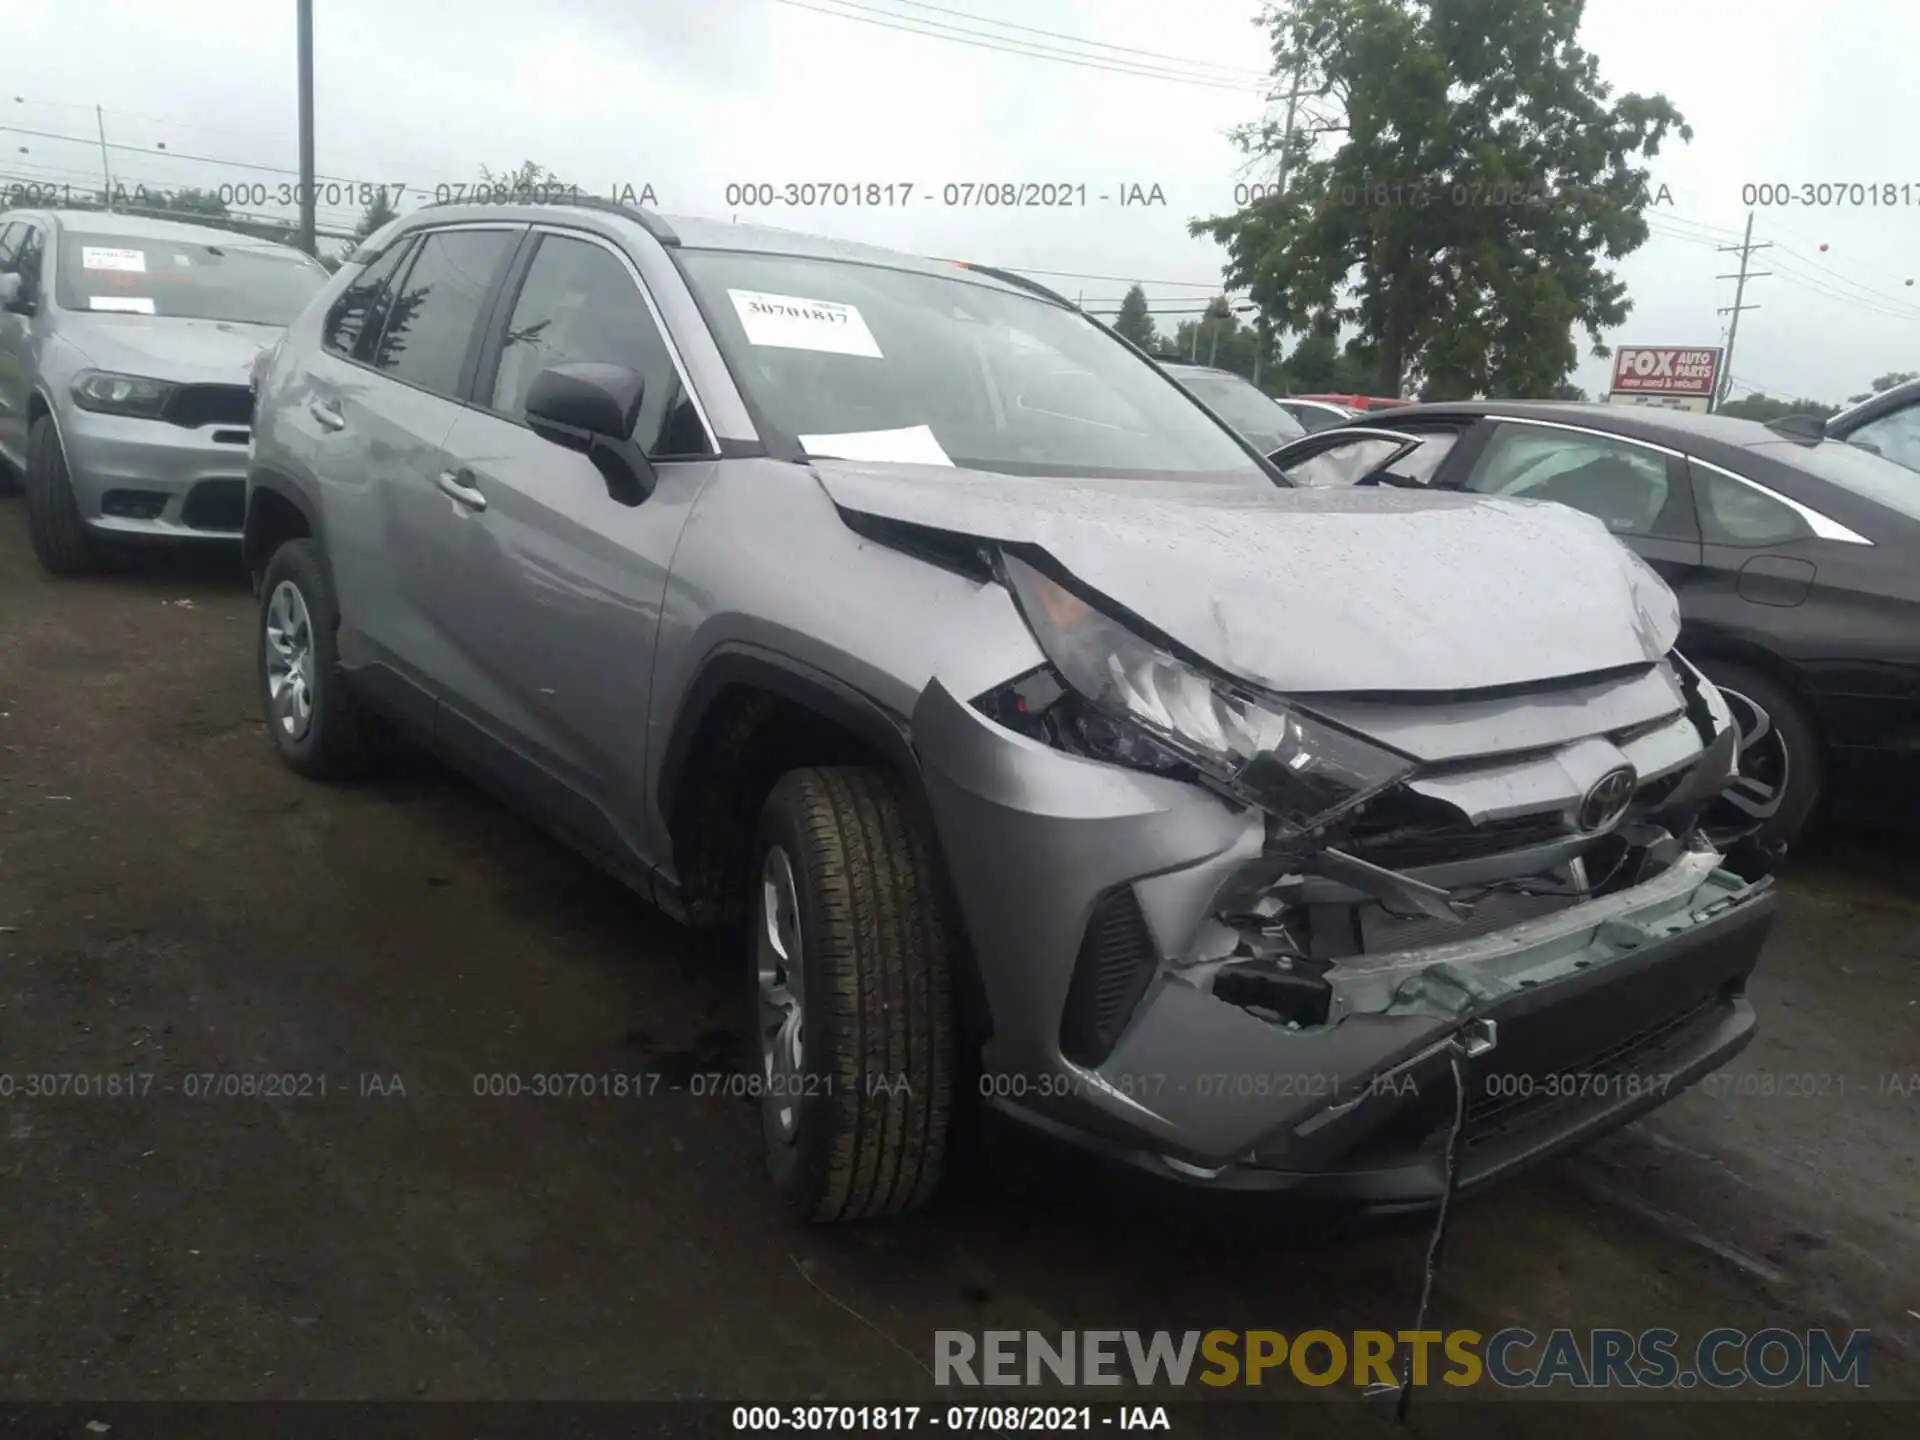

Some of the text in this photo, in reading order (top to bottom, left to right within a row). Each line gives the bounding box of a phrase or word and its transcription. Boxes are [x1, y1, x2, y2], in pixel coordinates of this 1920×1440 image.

[748, 301, 848, 324] 30701817
[1618, 350, 1677, 377] FOX
[1676, 351, 1711, 365] AUTO
[1674, 364, 1713, 378] PARTS
